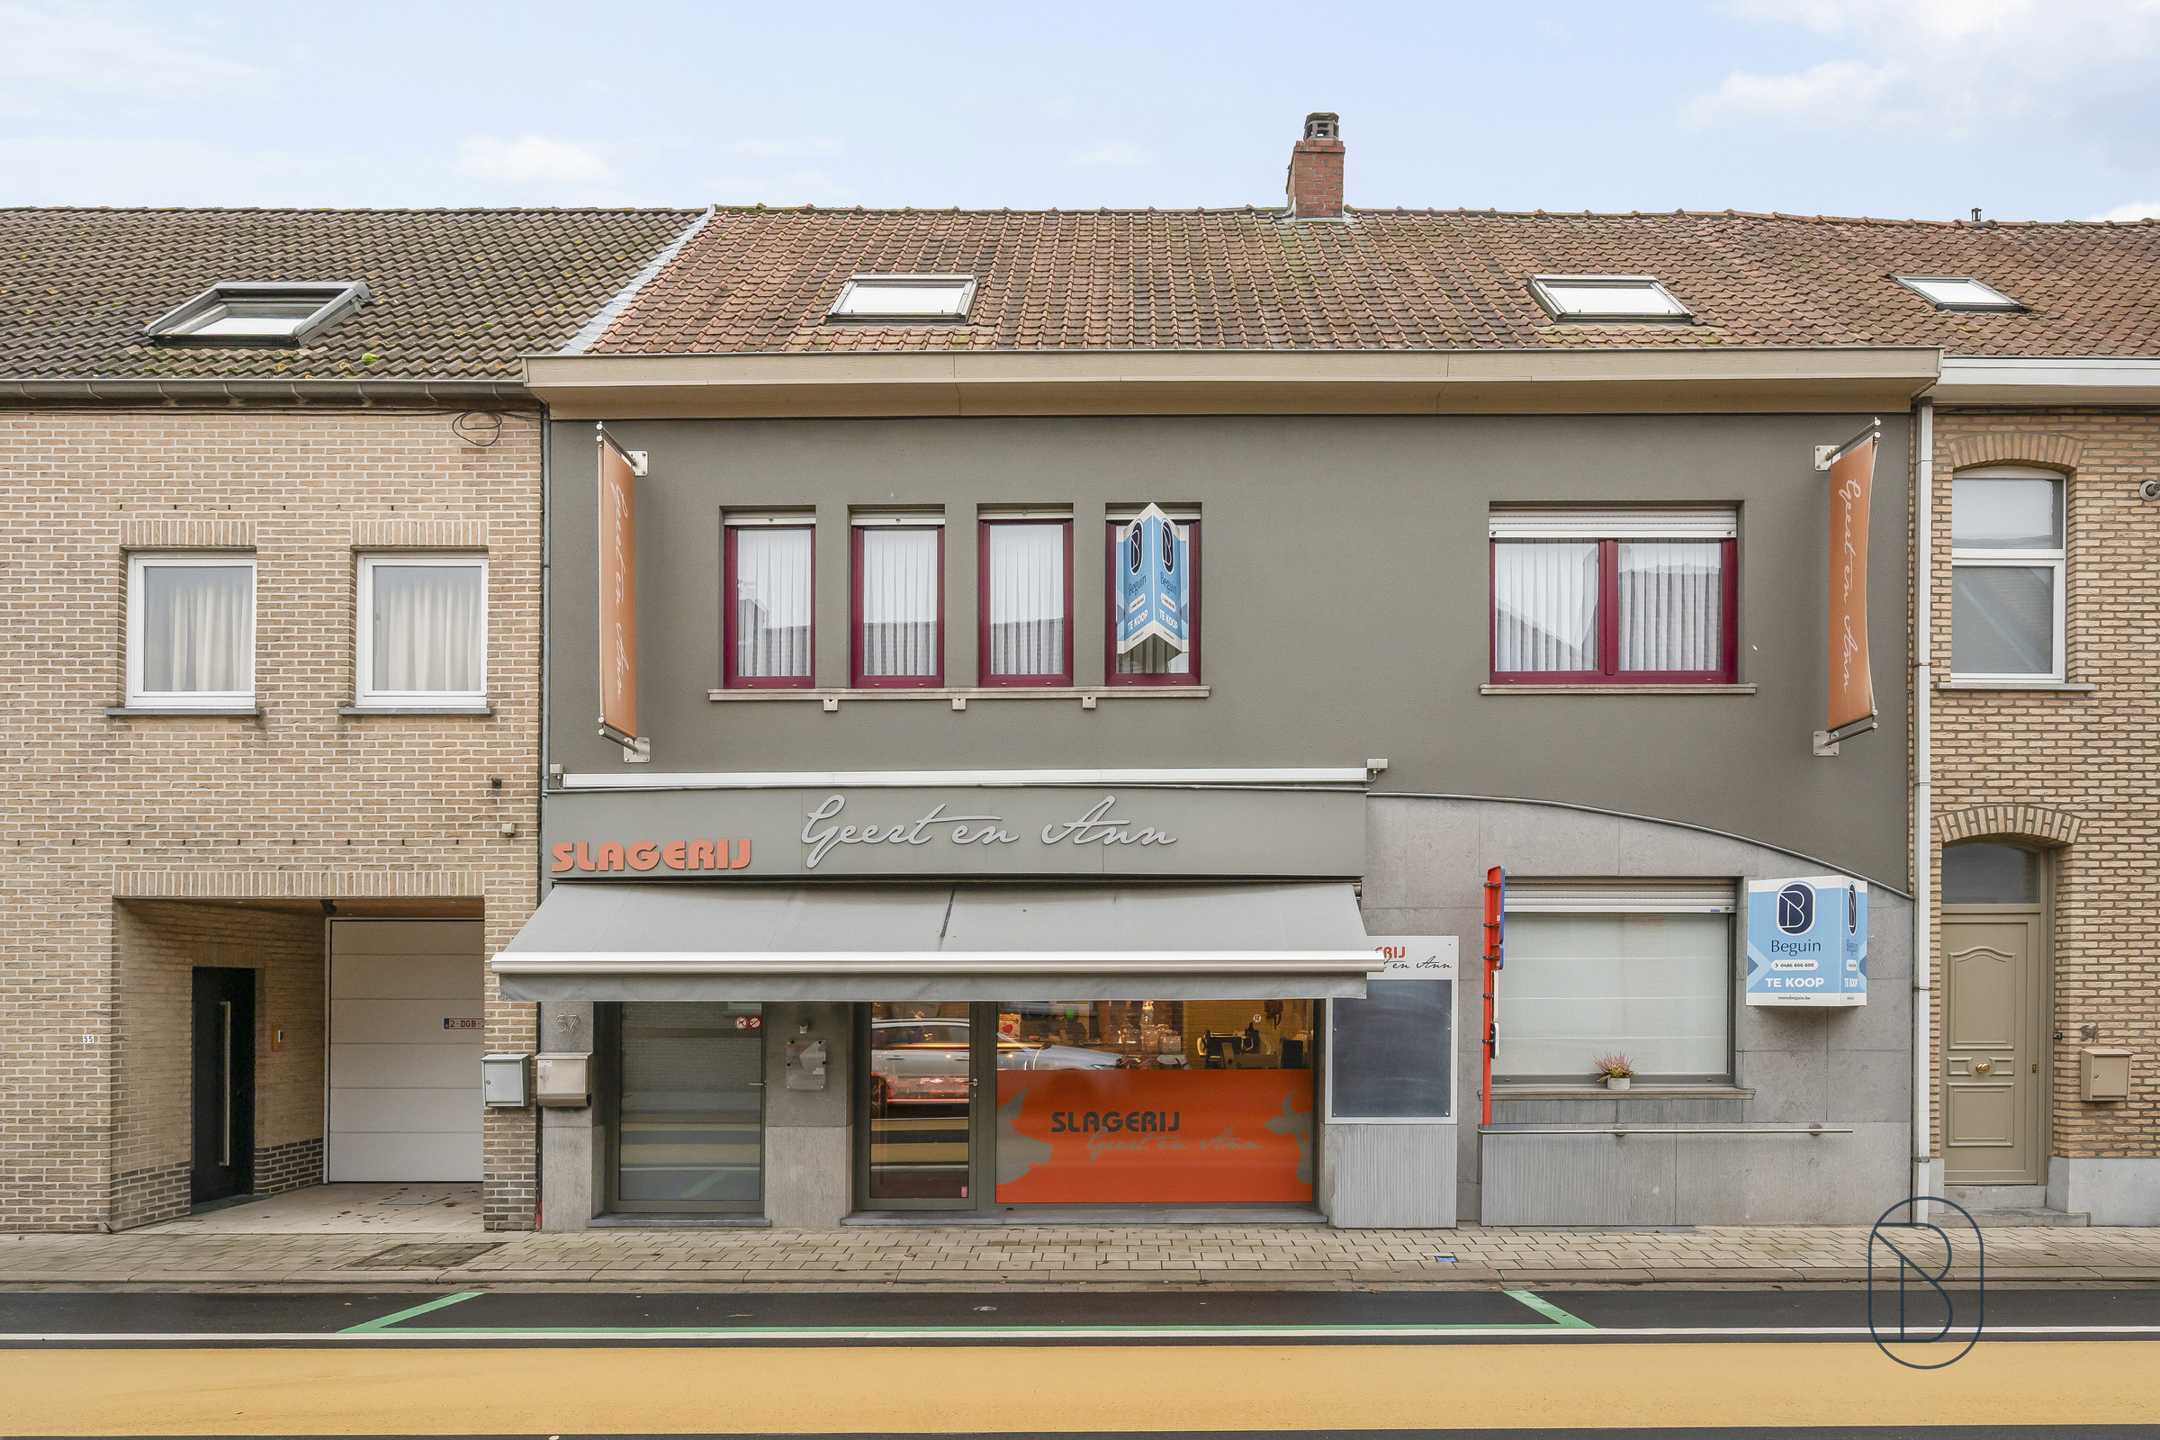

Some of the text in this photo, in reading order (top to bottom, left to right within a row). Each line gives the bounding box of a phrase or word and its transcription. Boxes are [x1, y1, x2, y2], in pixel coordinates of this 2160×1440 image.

[1839, 479, 1861, 693] Geert en Ann
[1128, 609, 1149, 632] TE KOOP
[1159, 608, 1179, 630] TE KOOP
[801, 794, 1178, 869] Geert en Ann
[552, 838, 751, 872] SLAGERIJ
[1771, 939, 1821, 957] Beguin
[1416, 955, 1452, 969] Ann
[1765, 977, 1825, 988] TE KOOP
[556, 1014, 579, 1033] 57
[83, 1035, 94, 1043] 55
[1051, 1110, 1180, 1133] SLAGERIJ
[1087, 1127, 1263, 1161] Geert en Ann
